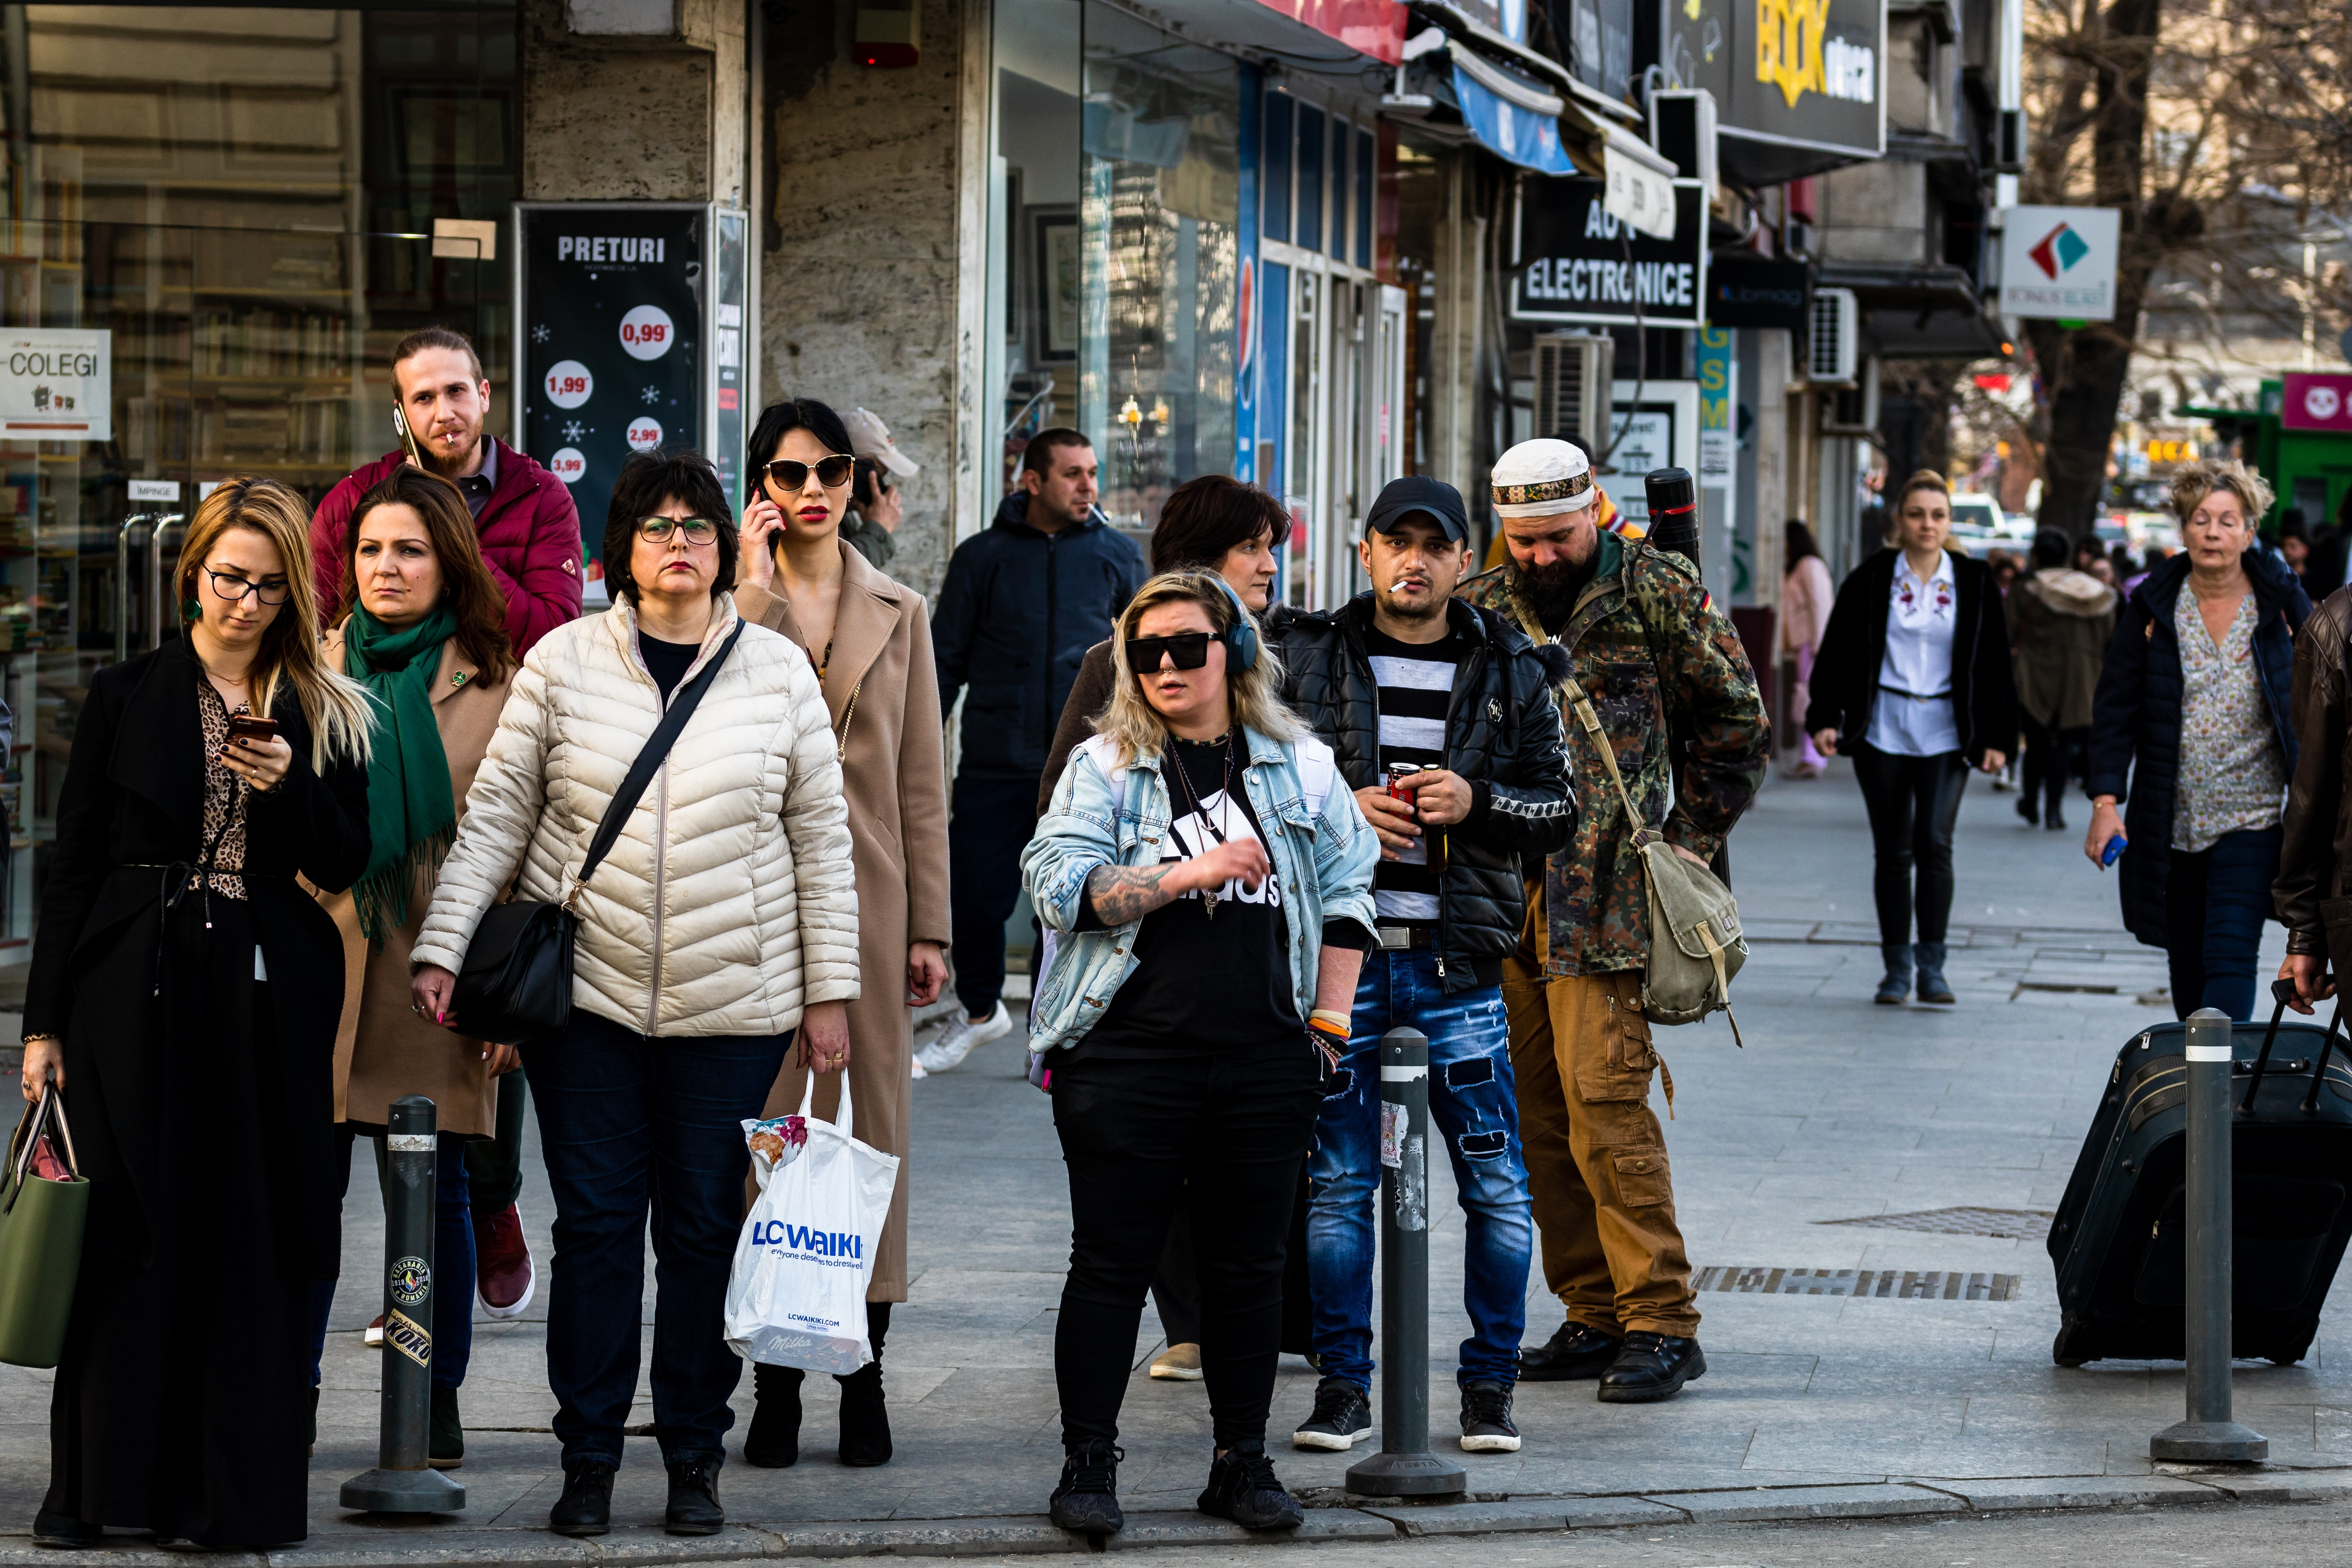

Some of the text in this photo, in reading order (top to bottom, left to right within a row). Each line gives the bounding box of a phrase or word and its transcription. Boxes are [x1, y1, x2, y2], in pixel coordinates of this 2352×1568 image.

[558, 236, 665, 263] PRETURI
[1526, 257, 1693, 307] ELECTRONICE
[622, 323, 666, 345] 0,99
[9, 352, 97, 377] COLEGI
[548, 376, 586, 396] 1,99
[629, 429, 658, 443] 2,99
[554, 459, 581, 473] 3,99
[393, 1261, 426, 1278] BASARABIA
[833, 1259, 851, 1268] dress
[416, 1275, 428, 1283] 2018
[788, 1313, 839, 1327] LCWAIKIKI.COM
[385, 1320, 431, 1360] KOKO
[767, 1334, 812, 1351] Milka
[1396, 1461, 1437, 1469] VESTA
